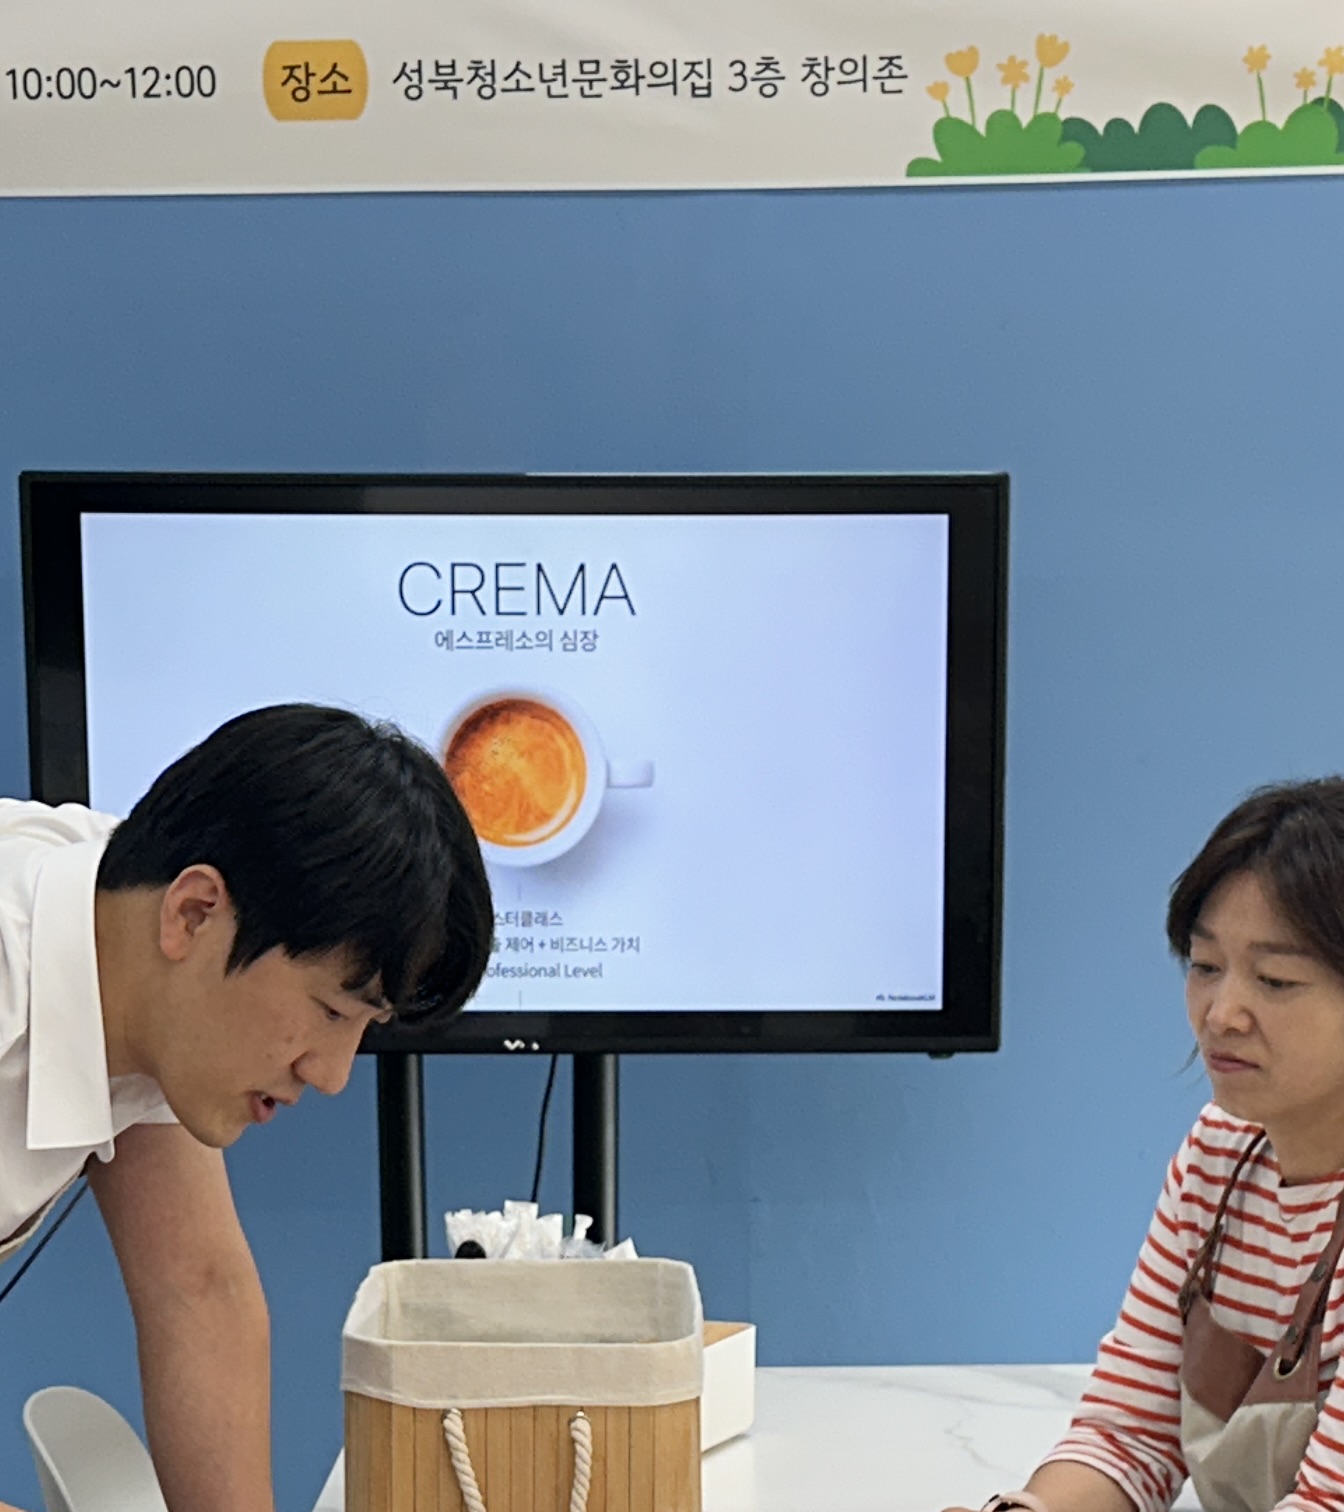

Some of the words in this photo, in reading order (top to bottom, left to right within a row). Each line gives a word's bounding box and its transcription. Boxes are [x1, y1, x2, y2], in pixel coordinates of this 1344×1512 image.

[5, 65, 216, 101] 10:00~12:00
[280, 61, 353, 103] 장소
[392, 58, 712, 101] 성북청소년문화의집
[728, 56, 786, 99] 3층
[801, 54, 908, 97] 창의존
[398, 561, 636, 617] CREMA
[434, 629, 553, 652] 에스프레소의
[559, 629, 600, 652] 심장
[494, 910, 564, 928] 스터클래스
[550, 936, 608, 953] 비즈니스
[611, 935, 641, 954] 가치
[487, 962, 561, 978] ofessional
[564, 962, 604, 978] Level
